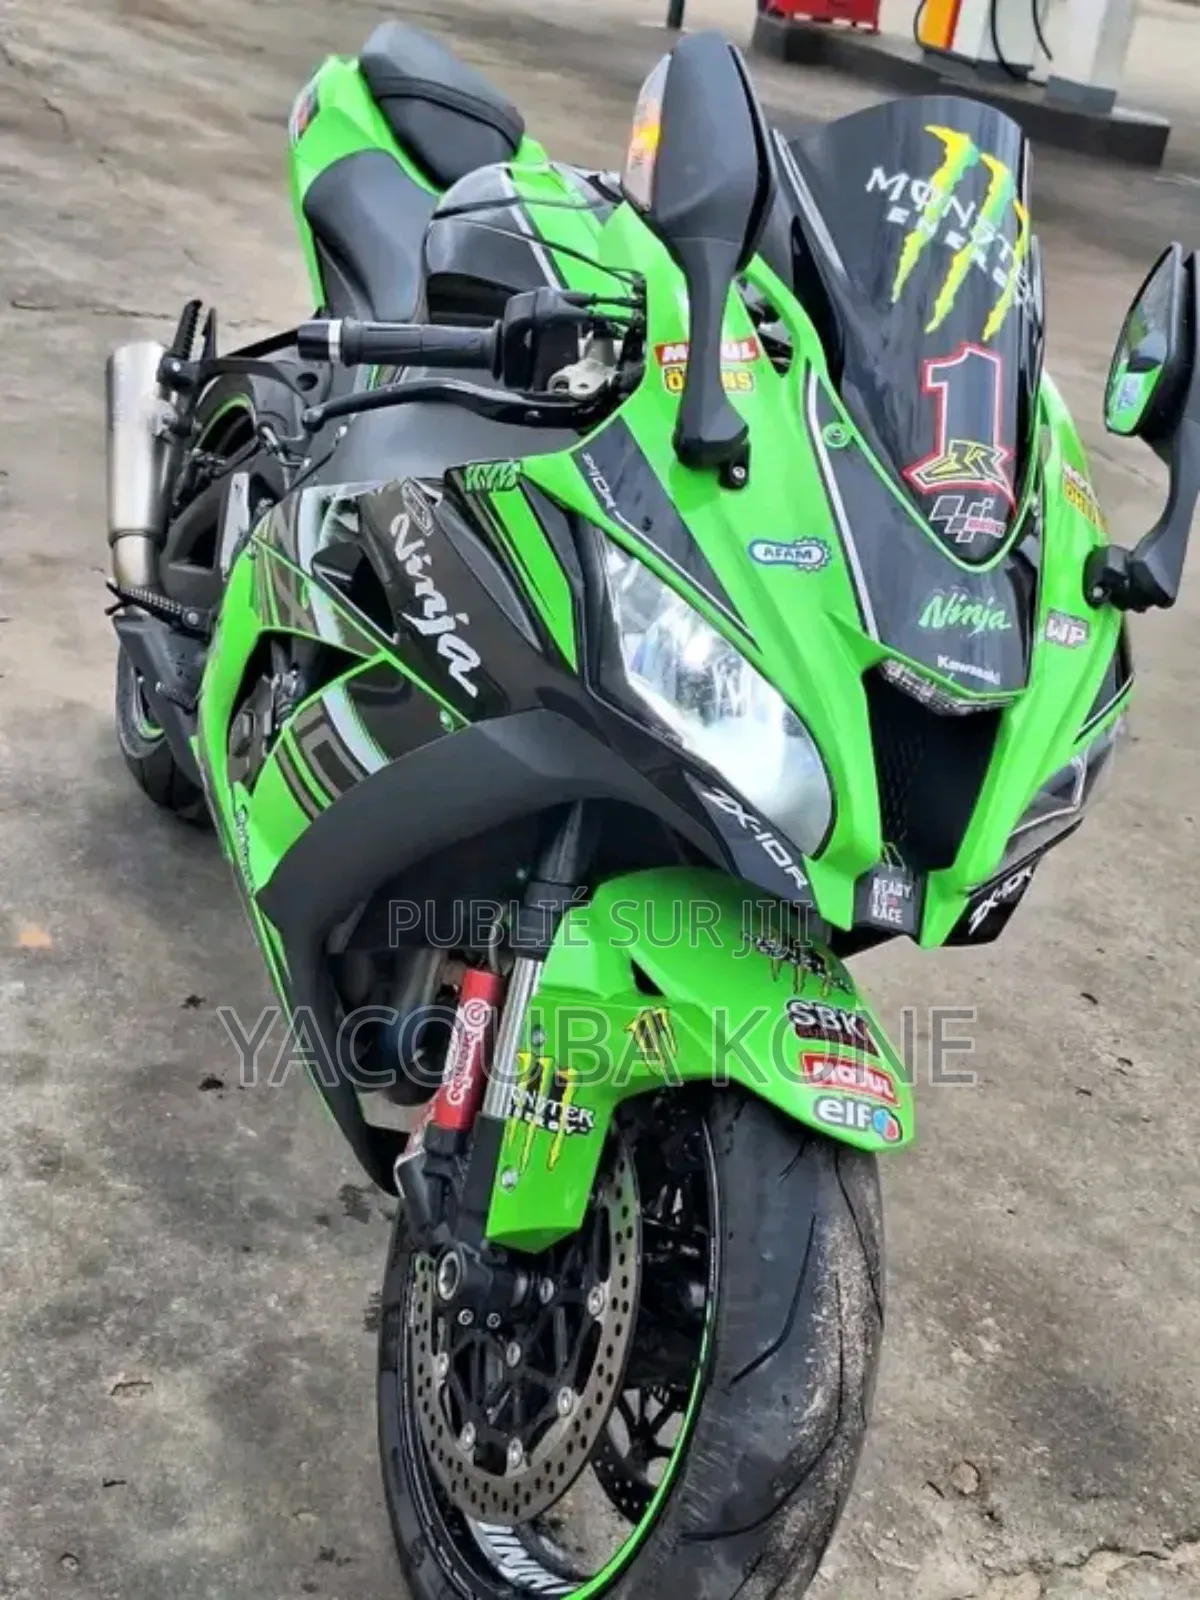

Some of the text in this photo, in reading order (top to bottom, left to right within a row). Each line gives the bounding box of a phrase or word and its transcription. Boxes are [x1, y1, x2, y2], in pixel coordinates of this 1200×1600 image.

[661, 338, 757, 363] MUL
[665, 366, 752, 392] ÖNS
[390, 513, 481, 698] Ninja
[918, 592, 1012, 638] Ninja
[702, 786, 808, 890] ZX-10R
[873, 877, 912, 899] READY
[871, 904, 903, 923] RACE
[787, 1000, 868, 1042] SBK
[817, 1098, 873, 1129] elf
